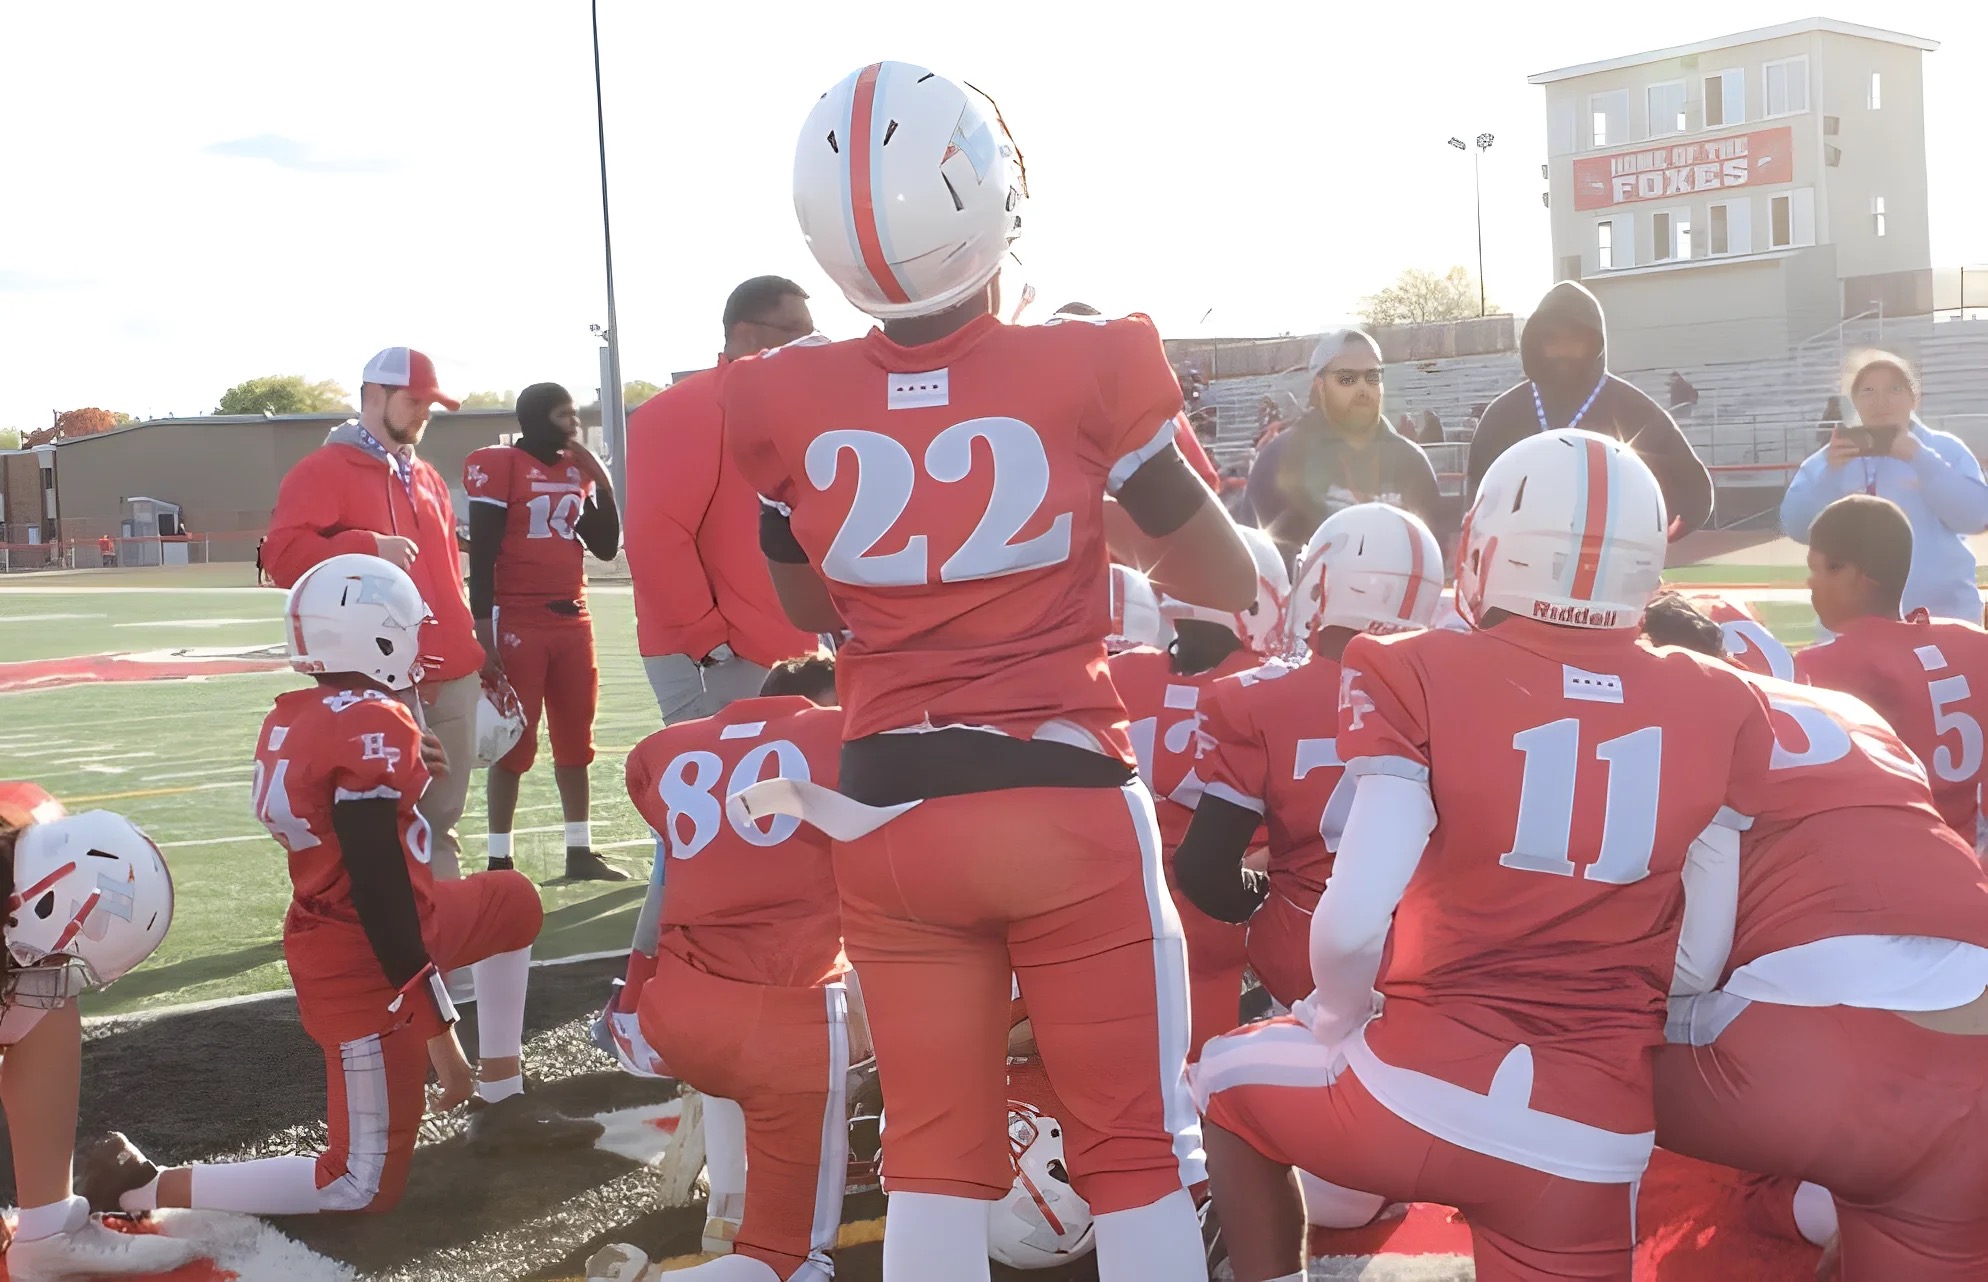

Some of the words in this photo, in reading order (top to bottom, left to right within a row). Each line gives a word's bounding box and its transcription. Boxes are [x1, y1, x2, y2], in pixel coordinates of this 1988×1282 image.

[1612, 157, 1749, 204] FOXES
[804, 416, 1073, 587] 22
[658, 739, 812, 860] 80
[1499, 717, 1663, 885] 11
